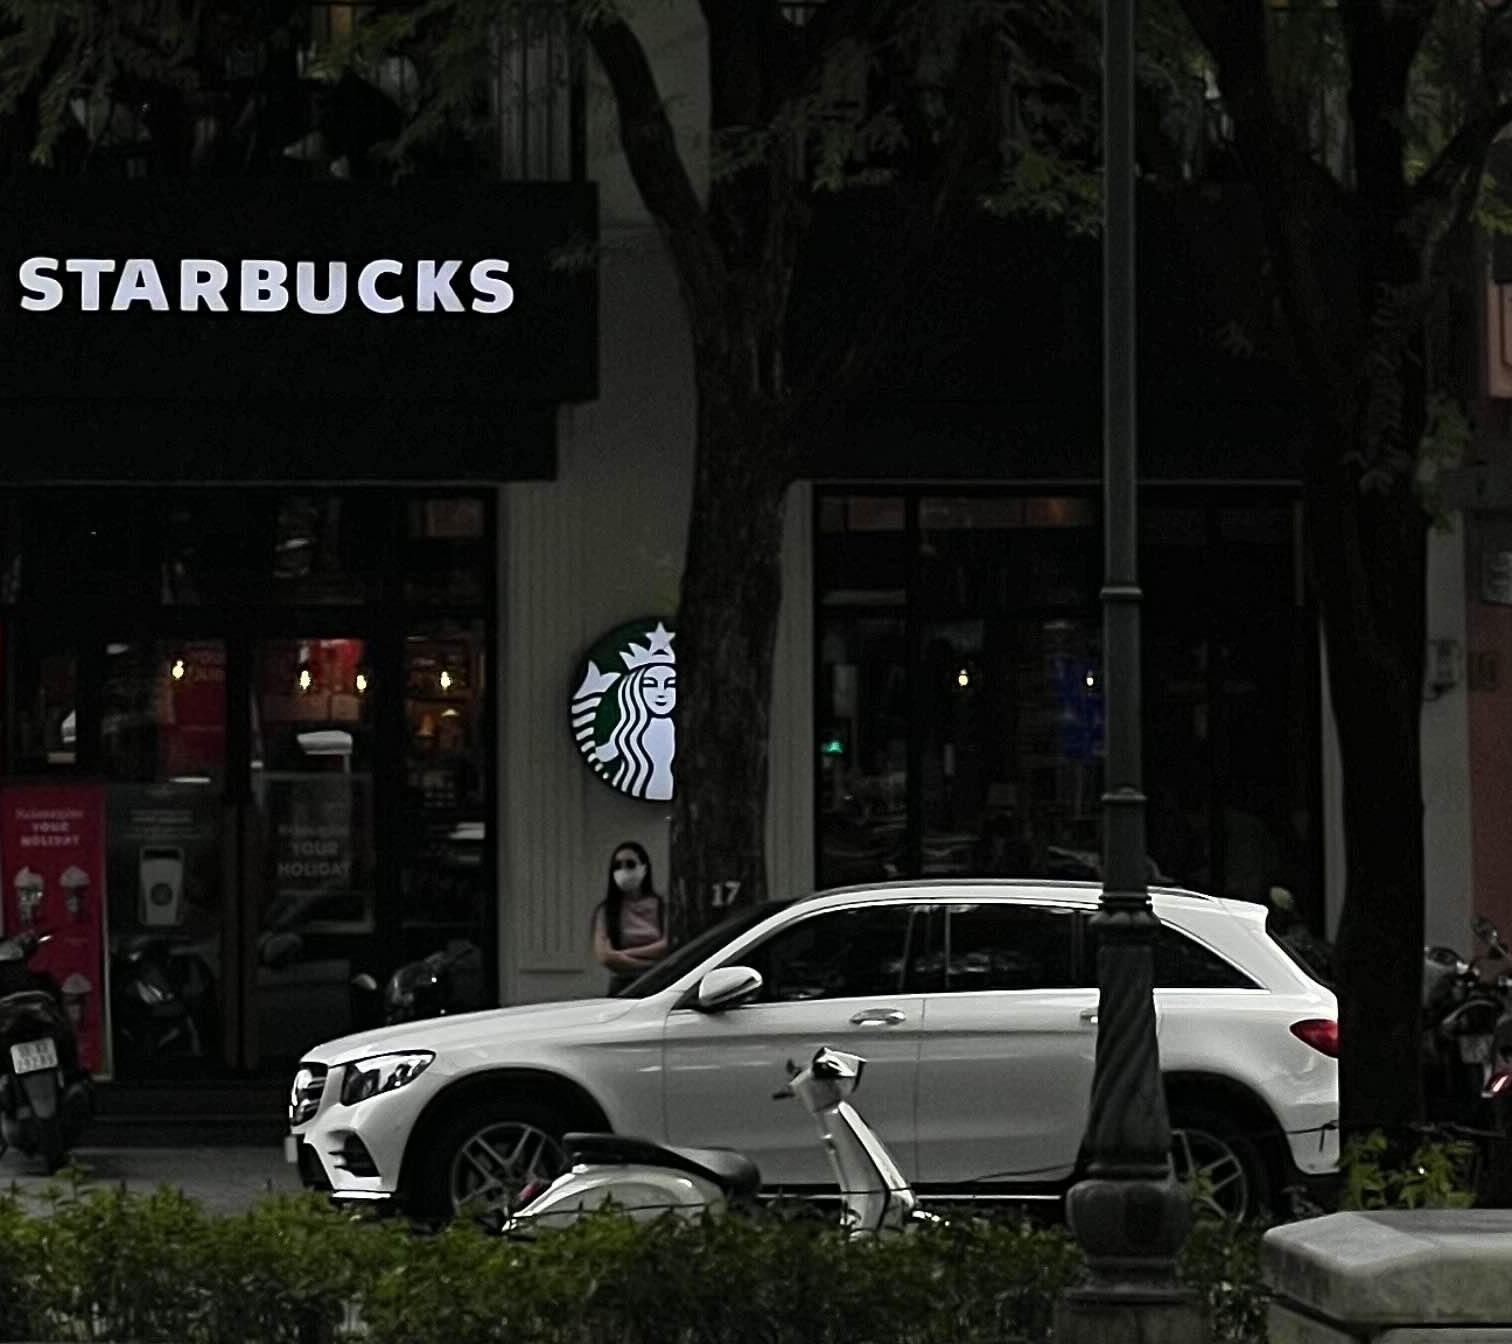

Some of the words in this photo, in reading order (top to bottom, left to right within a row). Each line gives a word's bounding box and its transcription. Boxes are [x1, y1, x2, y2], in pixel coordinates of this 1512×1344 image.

[18, 255, 514, 315] STARBUCKS
[277, 862, 351, 878] HOLIDAY
[711, 880, 742, 907] 17
